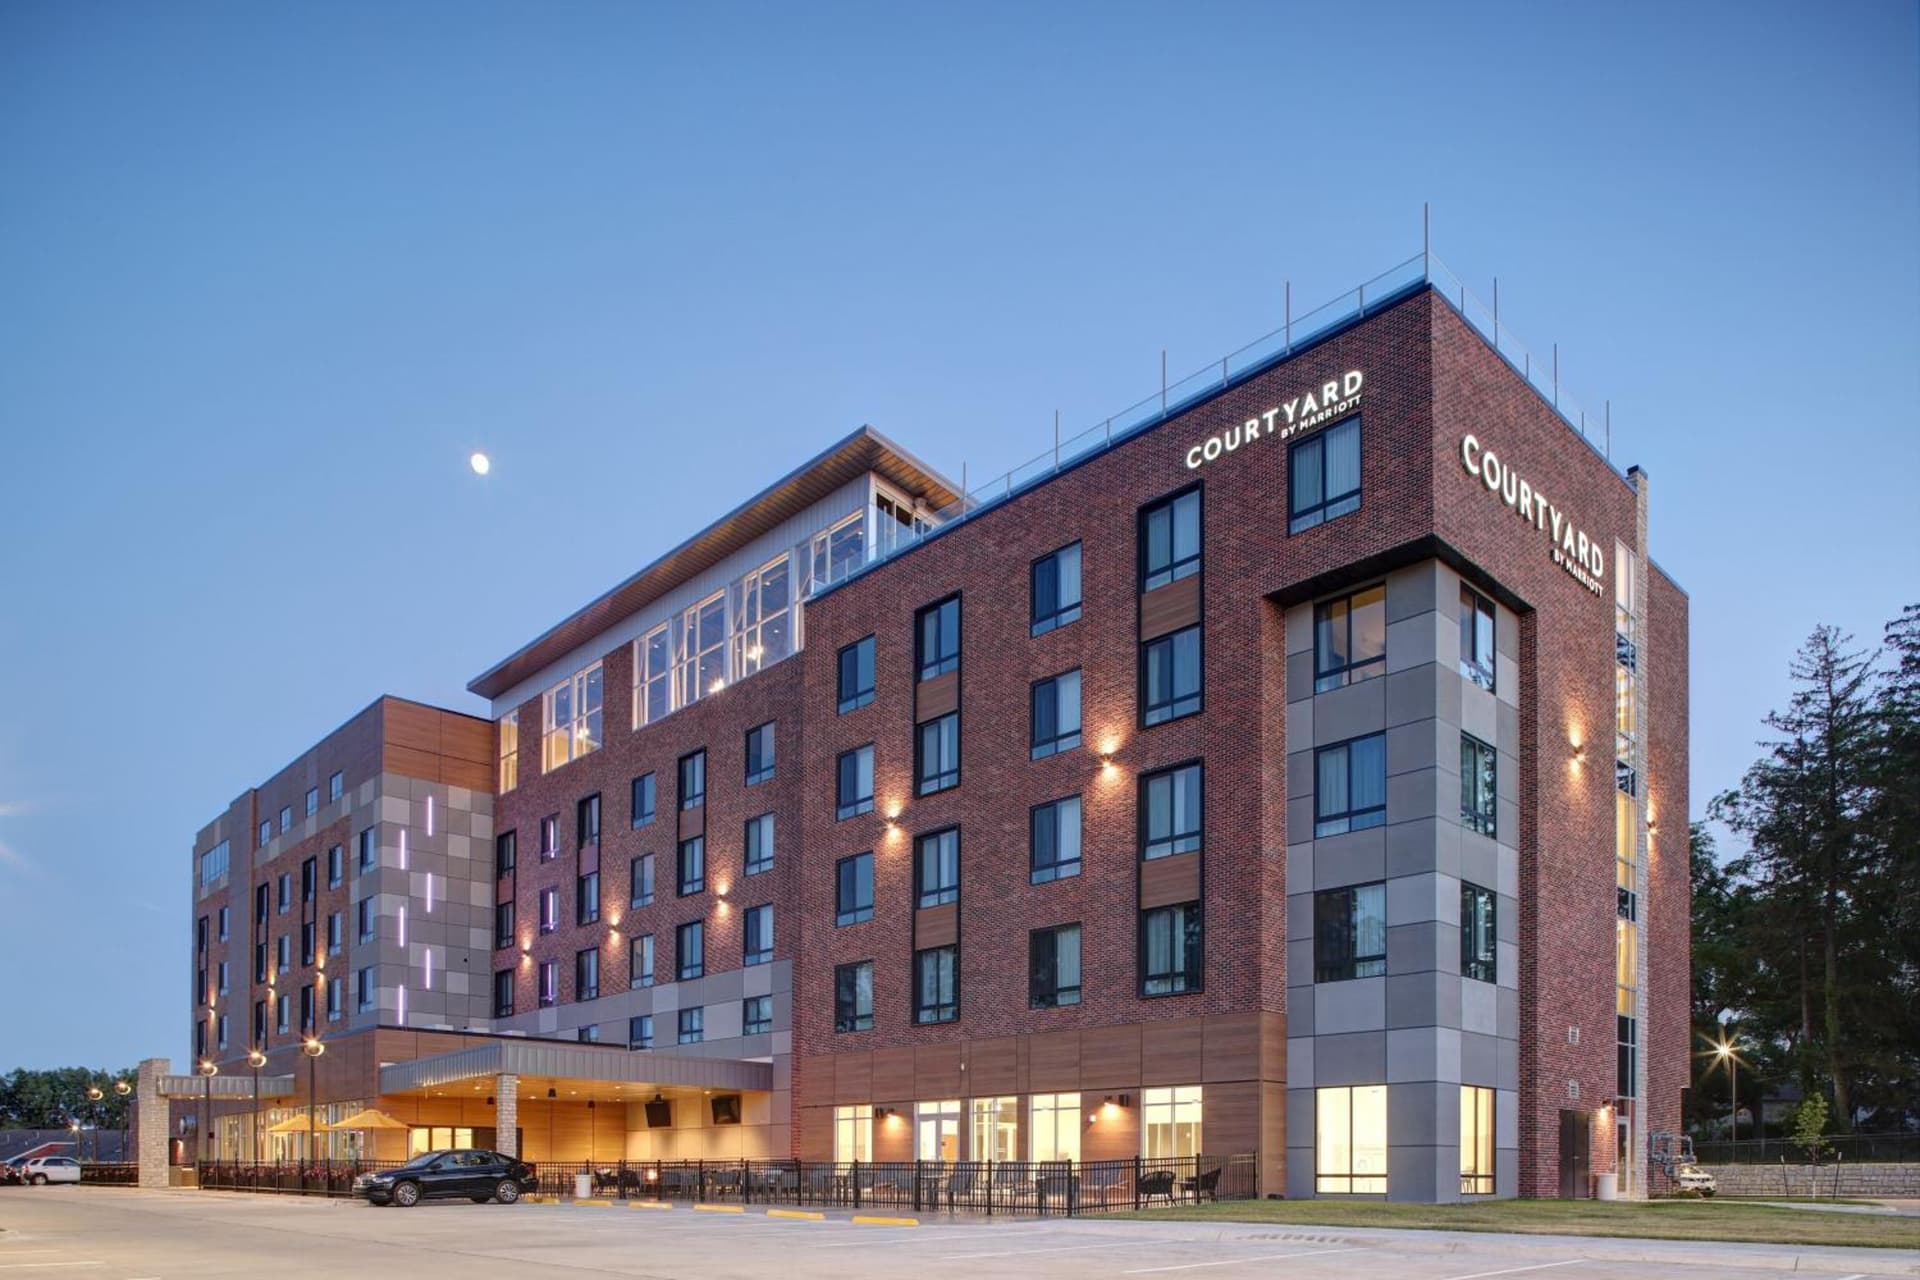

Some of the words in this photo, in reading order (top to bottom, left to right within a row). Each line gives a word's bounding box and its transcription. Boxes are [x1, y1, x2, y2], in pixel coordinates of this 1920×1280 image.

[1186, 370, 1363, 469] COURTYARD
[1281, 424, 1296, 439] BY
[1300, 394, 1361, 431] MARRIOTT
[1463, 434, 1604, 578] COURTYARD
[1554, 548, 1565, 566] BY
[1566, 557, 1603, 598] MARRIOTT
